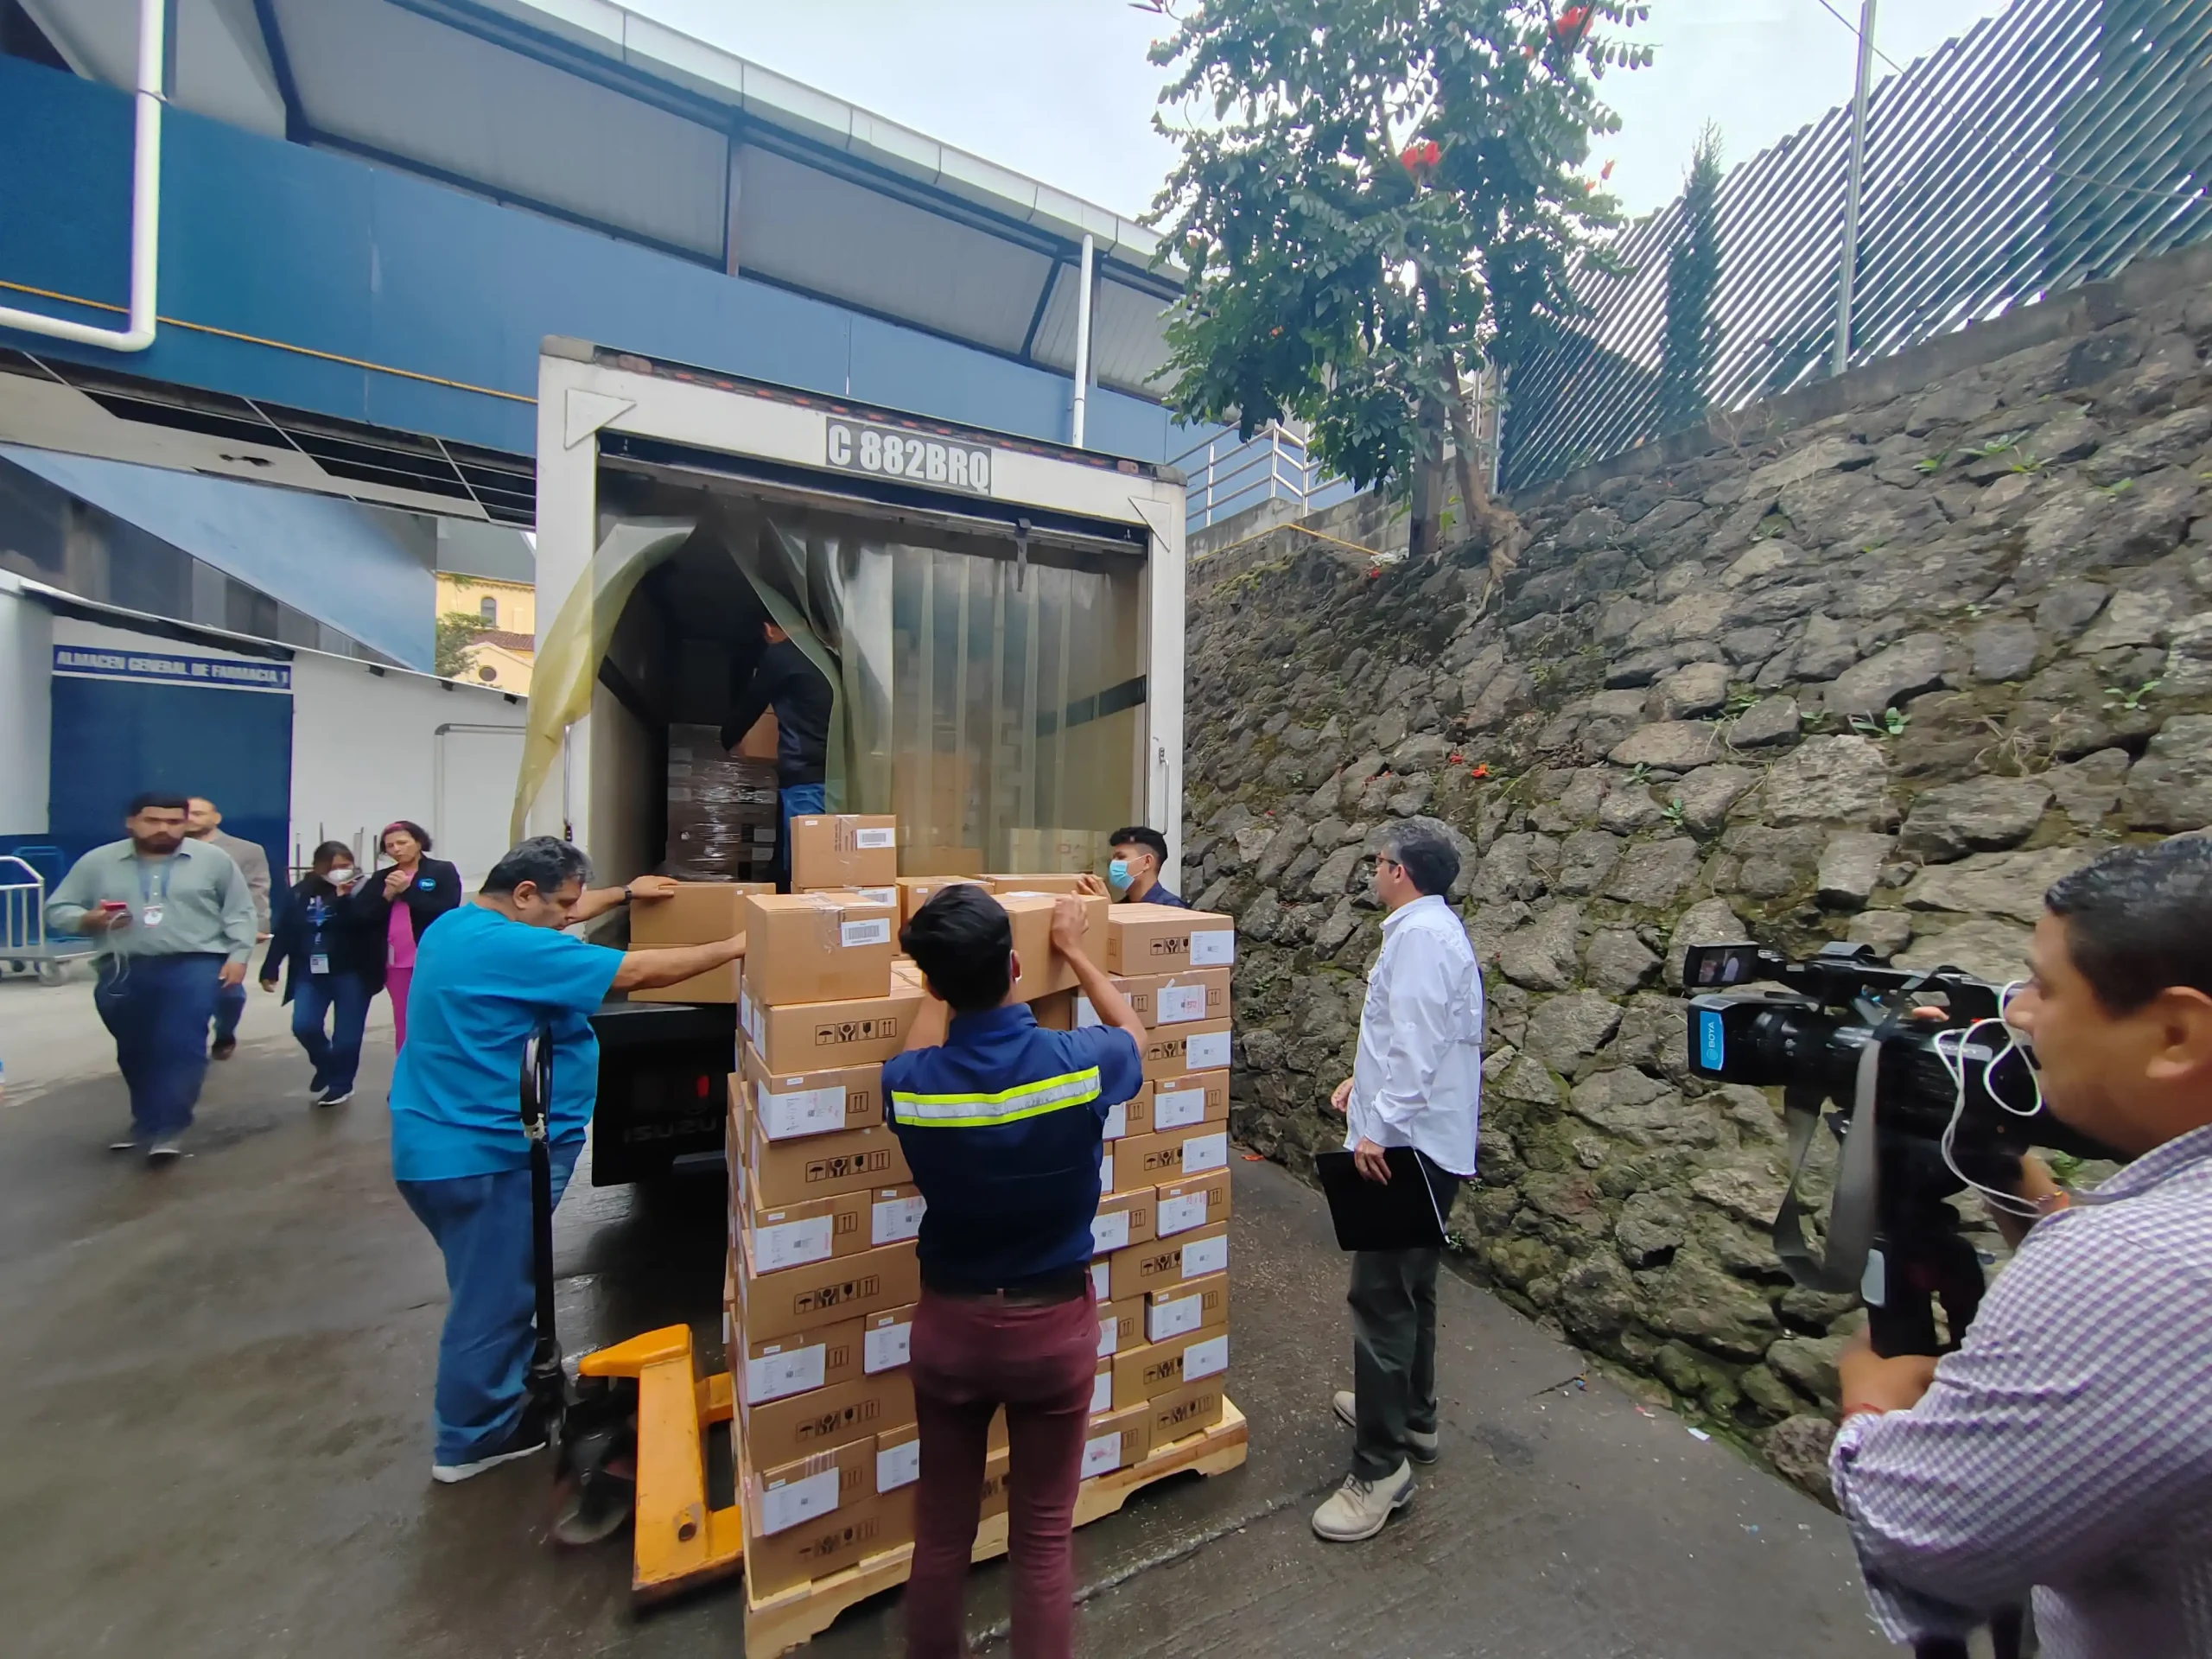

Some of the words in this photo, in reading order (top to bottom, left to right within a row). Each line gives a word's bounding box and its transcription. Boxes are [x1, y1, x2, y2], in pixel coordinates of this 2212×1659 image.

[829, 424, 851, 466] C
[860, 430, 990, 496] 882BRQ
[57, 651, 126, 670] ALMACEN
[129, 658, 191, 676] GENERAL
[191, 663, 211, 677] DE
[212, 664, 278, 683] FARMACIA
